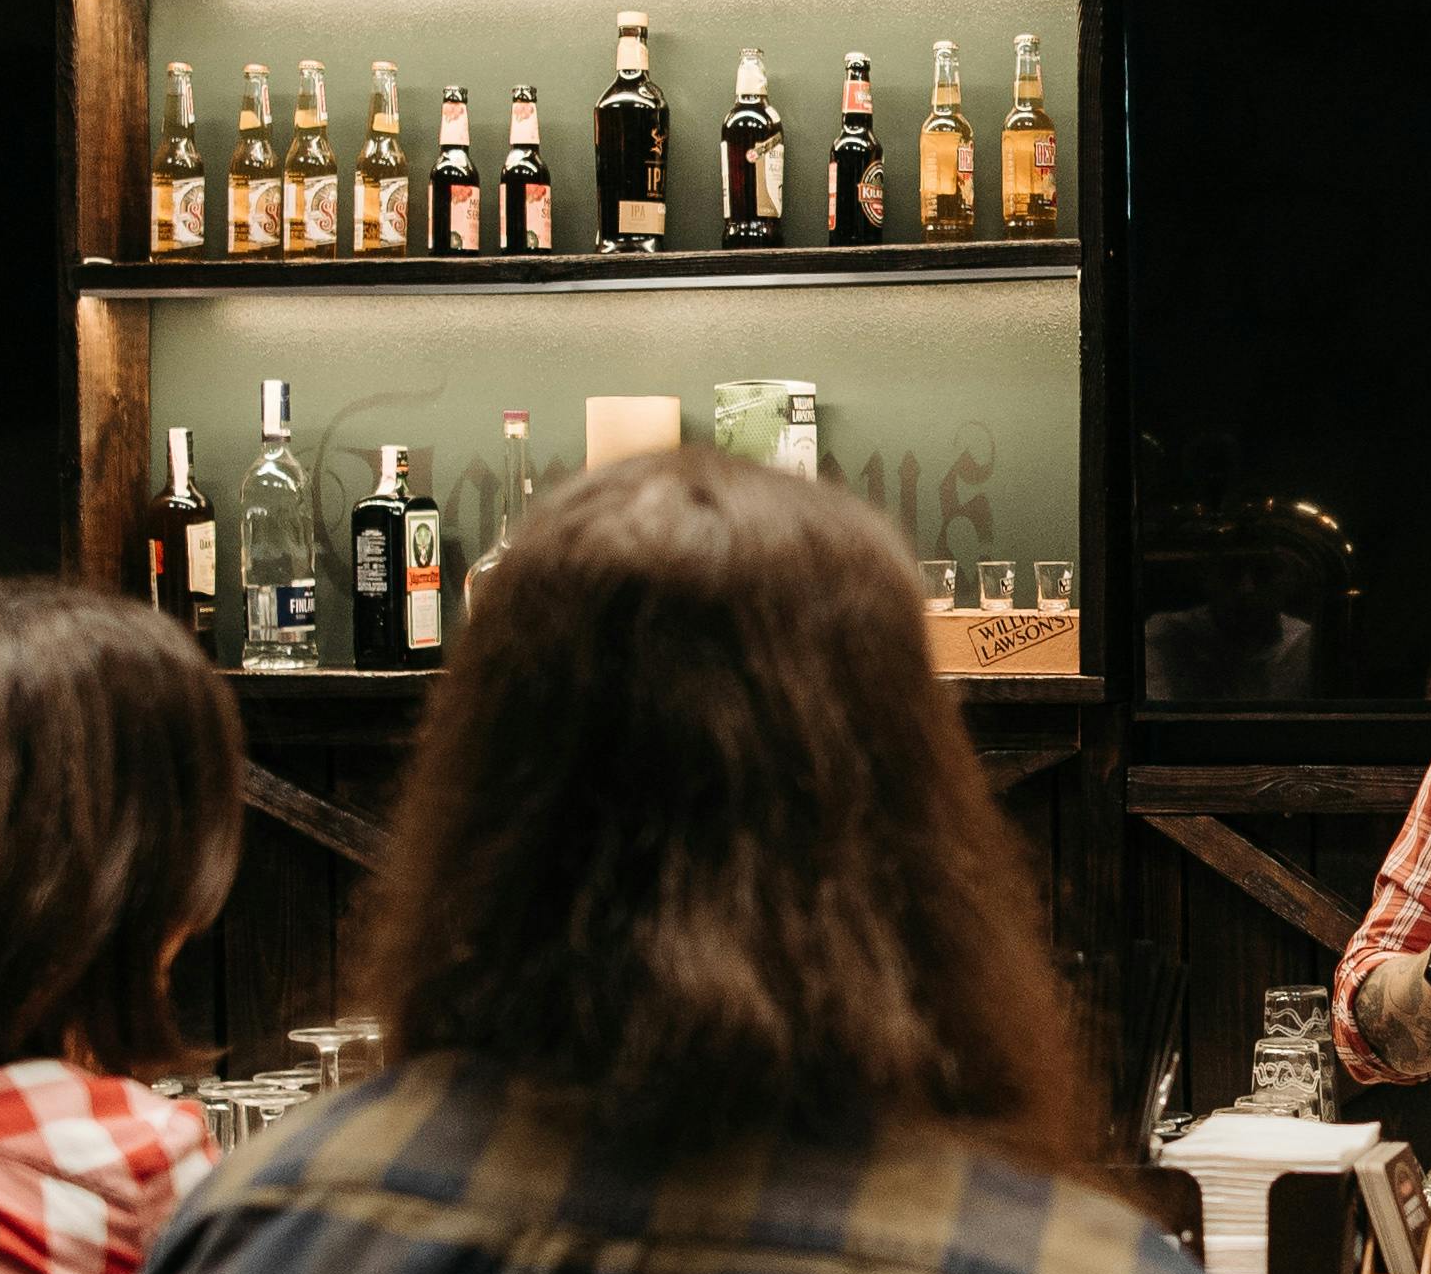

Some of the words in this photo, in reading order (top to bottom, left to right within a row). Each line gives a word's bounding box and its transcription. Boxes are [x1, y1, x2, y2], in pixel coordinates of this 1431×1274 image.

[647, 167, 666, 193] IP
[630, 204, 646, 217] IPA
[978, 614, 1039, 641] WILLI
[981, 616, 1066, 660] LAWSON'S
